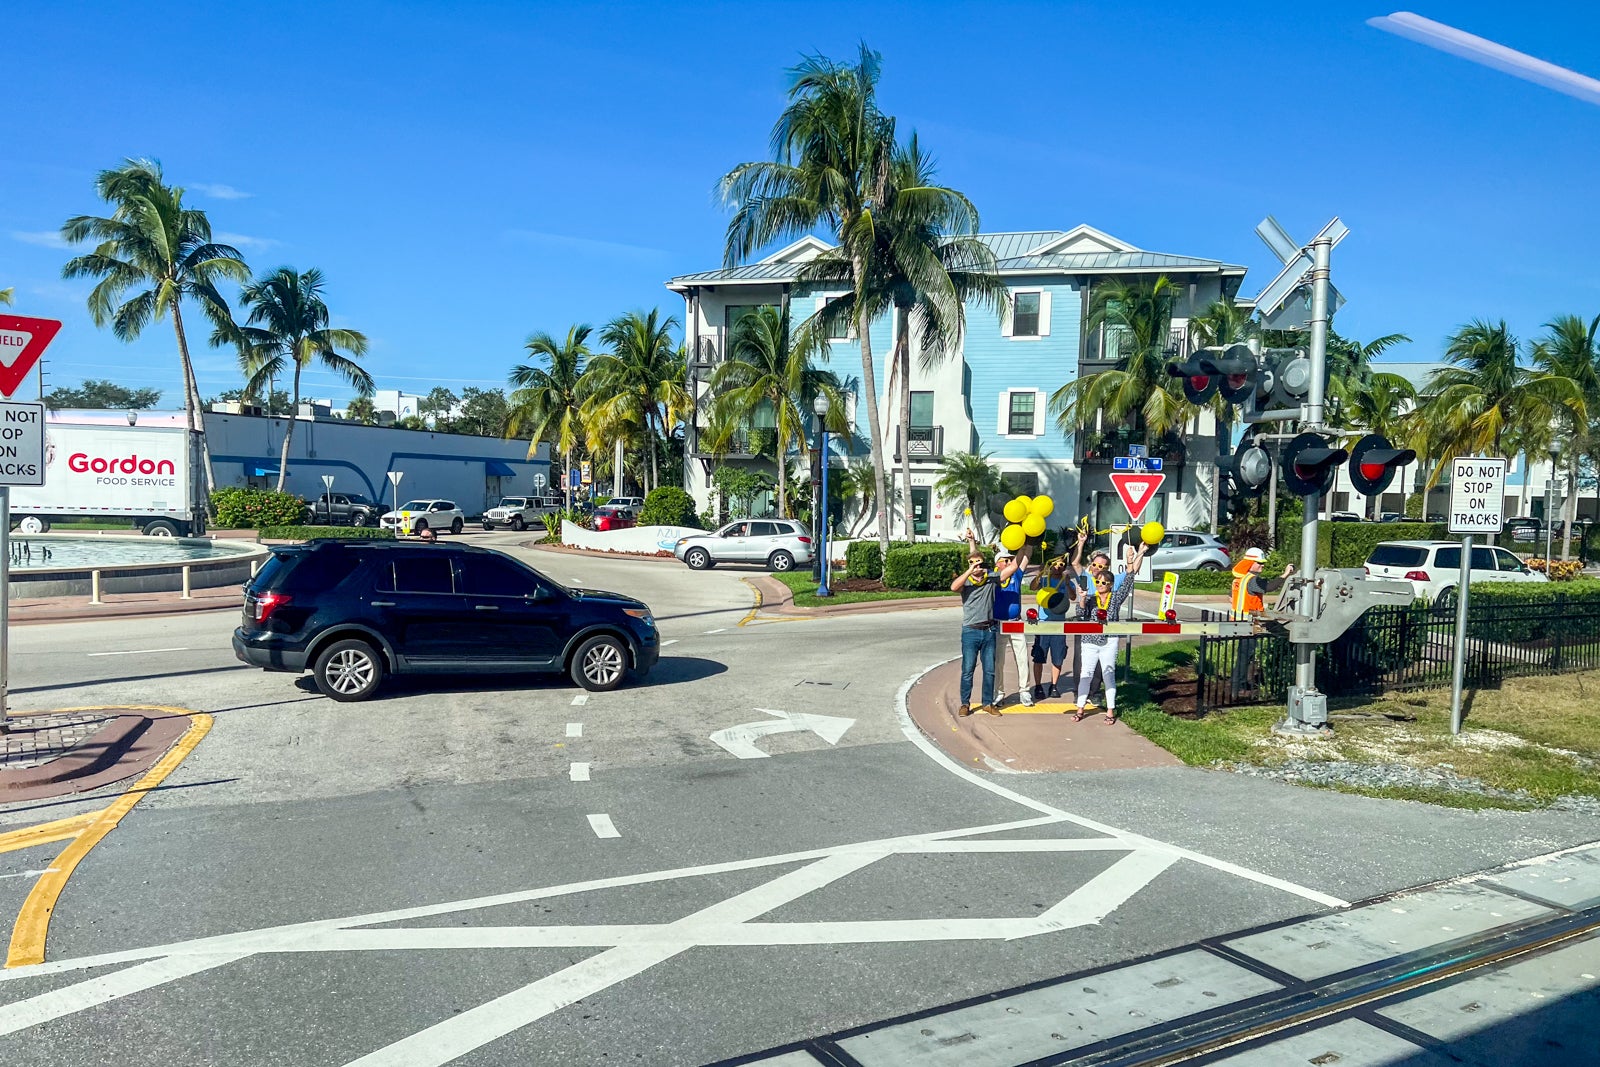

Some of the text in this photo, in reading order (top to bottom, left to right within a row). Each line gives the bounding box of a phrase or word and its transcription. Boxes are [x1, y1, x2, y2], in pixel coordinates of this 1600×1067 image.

[0, 335, 23, 346] IELD
[5, 410, 38, 423] NOT
[0, 428, 23, 440] OP
[68, 453, 175, 475] Gordon
[1127, 458, 1148, 469] DIXIE
[1457, 466, 1502, 478] DO NOT
[96, 477, 175, 487] FOOD SERVICE
[1464, 482, 1493, 493] STOP
[1469, 498, 1485, 509] ON
[1454, 513, 1498, 525] TRACKS
